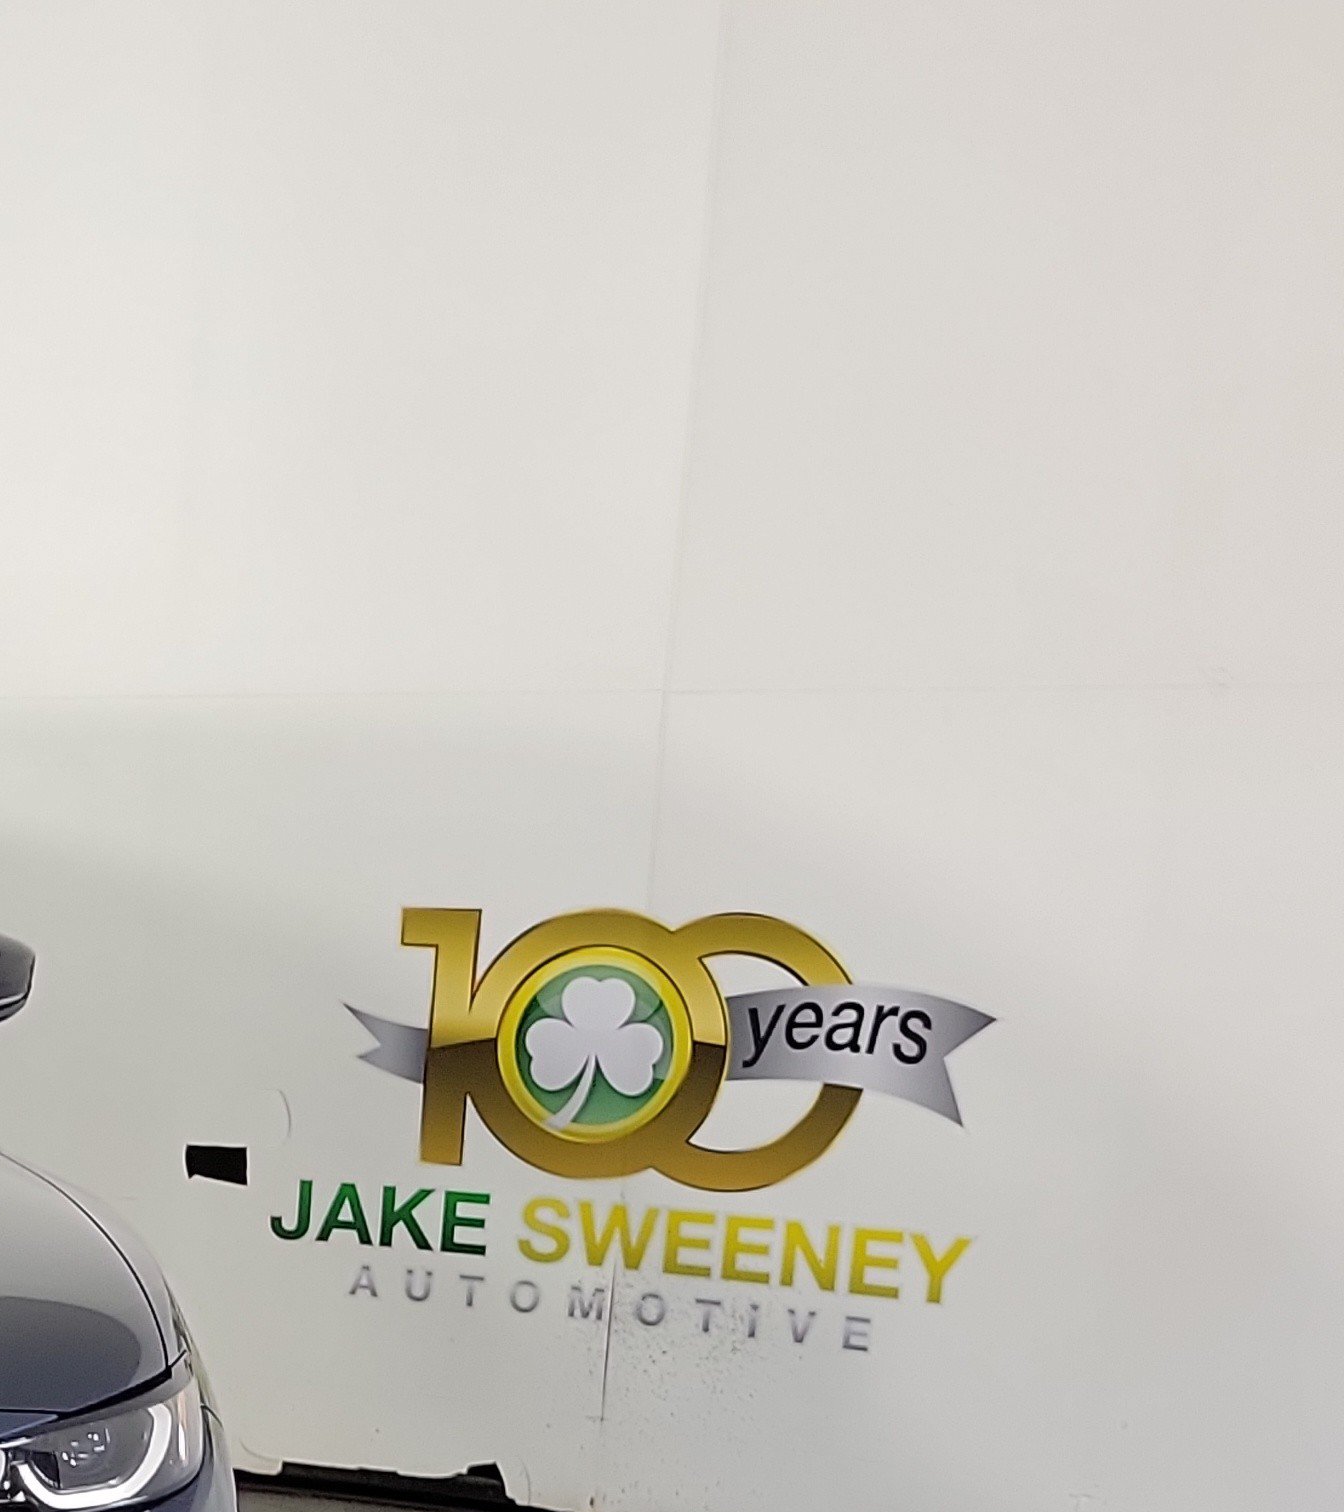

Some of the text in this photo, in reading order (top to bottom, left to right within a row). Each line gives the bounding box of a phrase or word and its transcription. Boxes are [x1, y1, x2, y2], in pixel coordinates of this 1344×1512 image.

[401, 907, 933, 1192] 100 years
[269, 1179, 973, 1304] JAKE SWEENEY
[349, 1264, 873, 1352] AUTOMOTIVE
